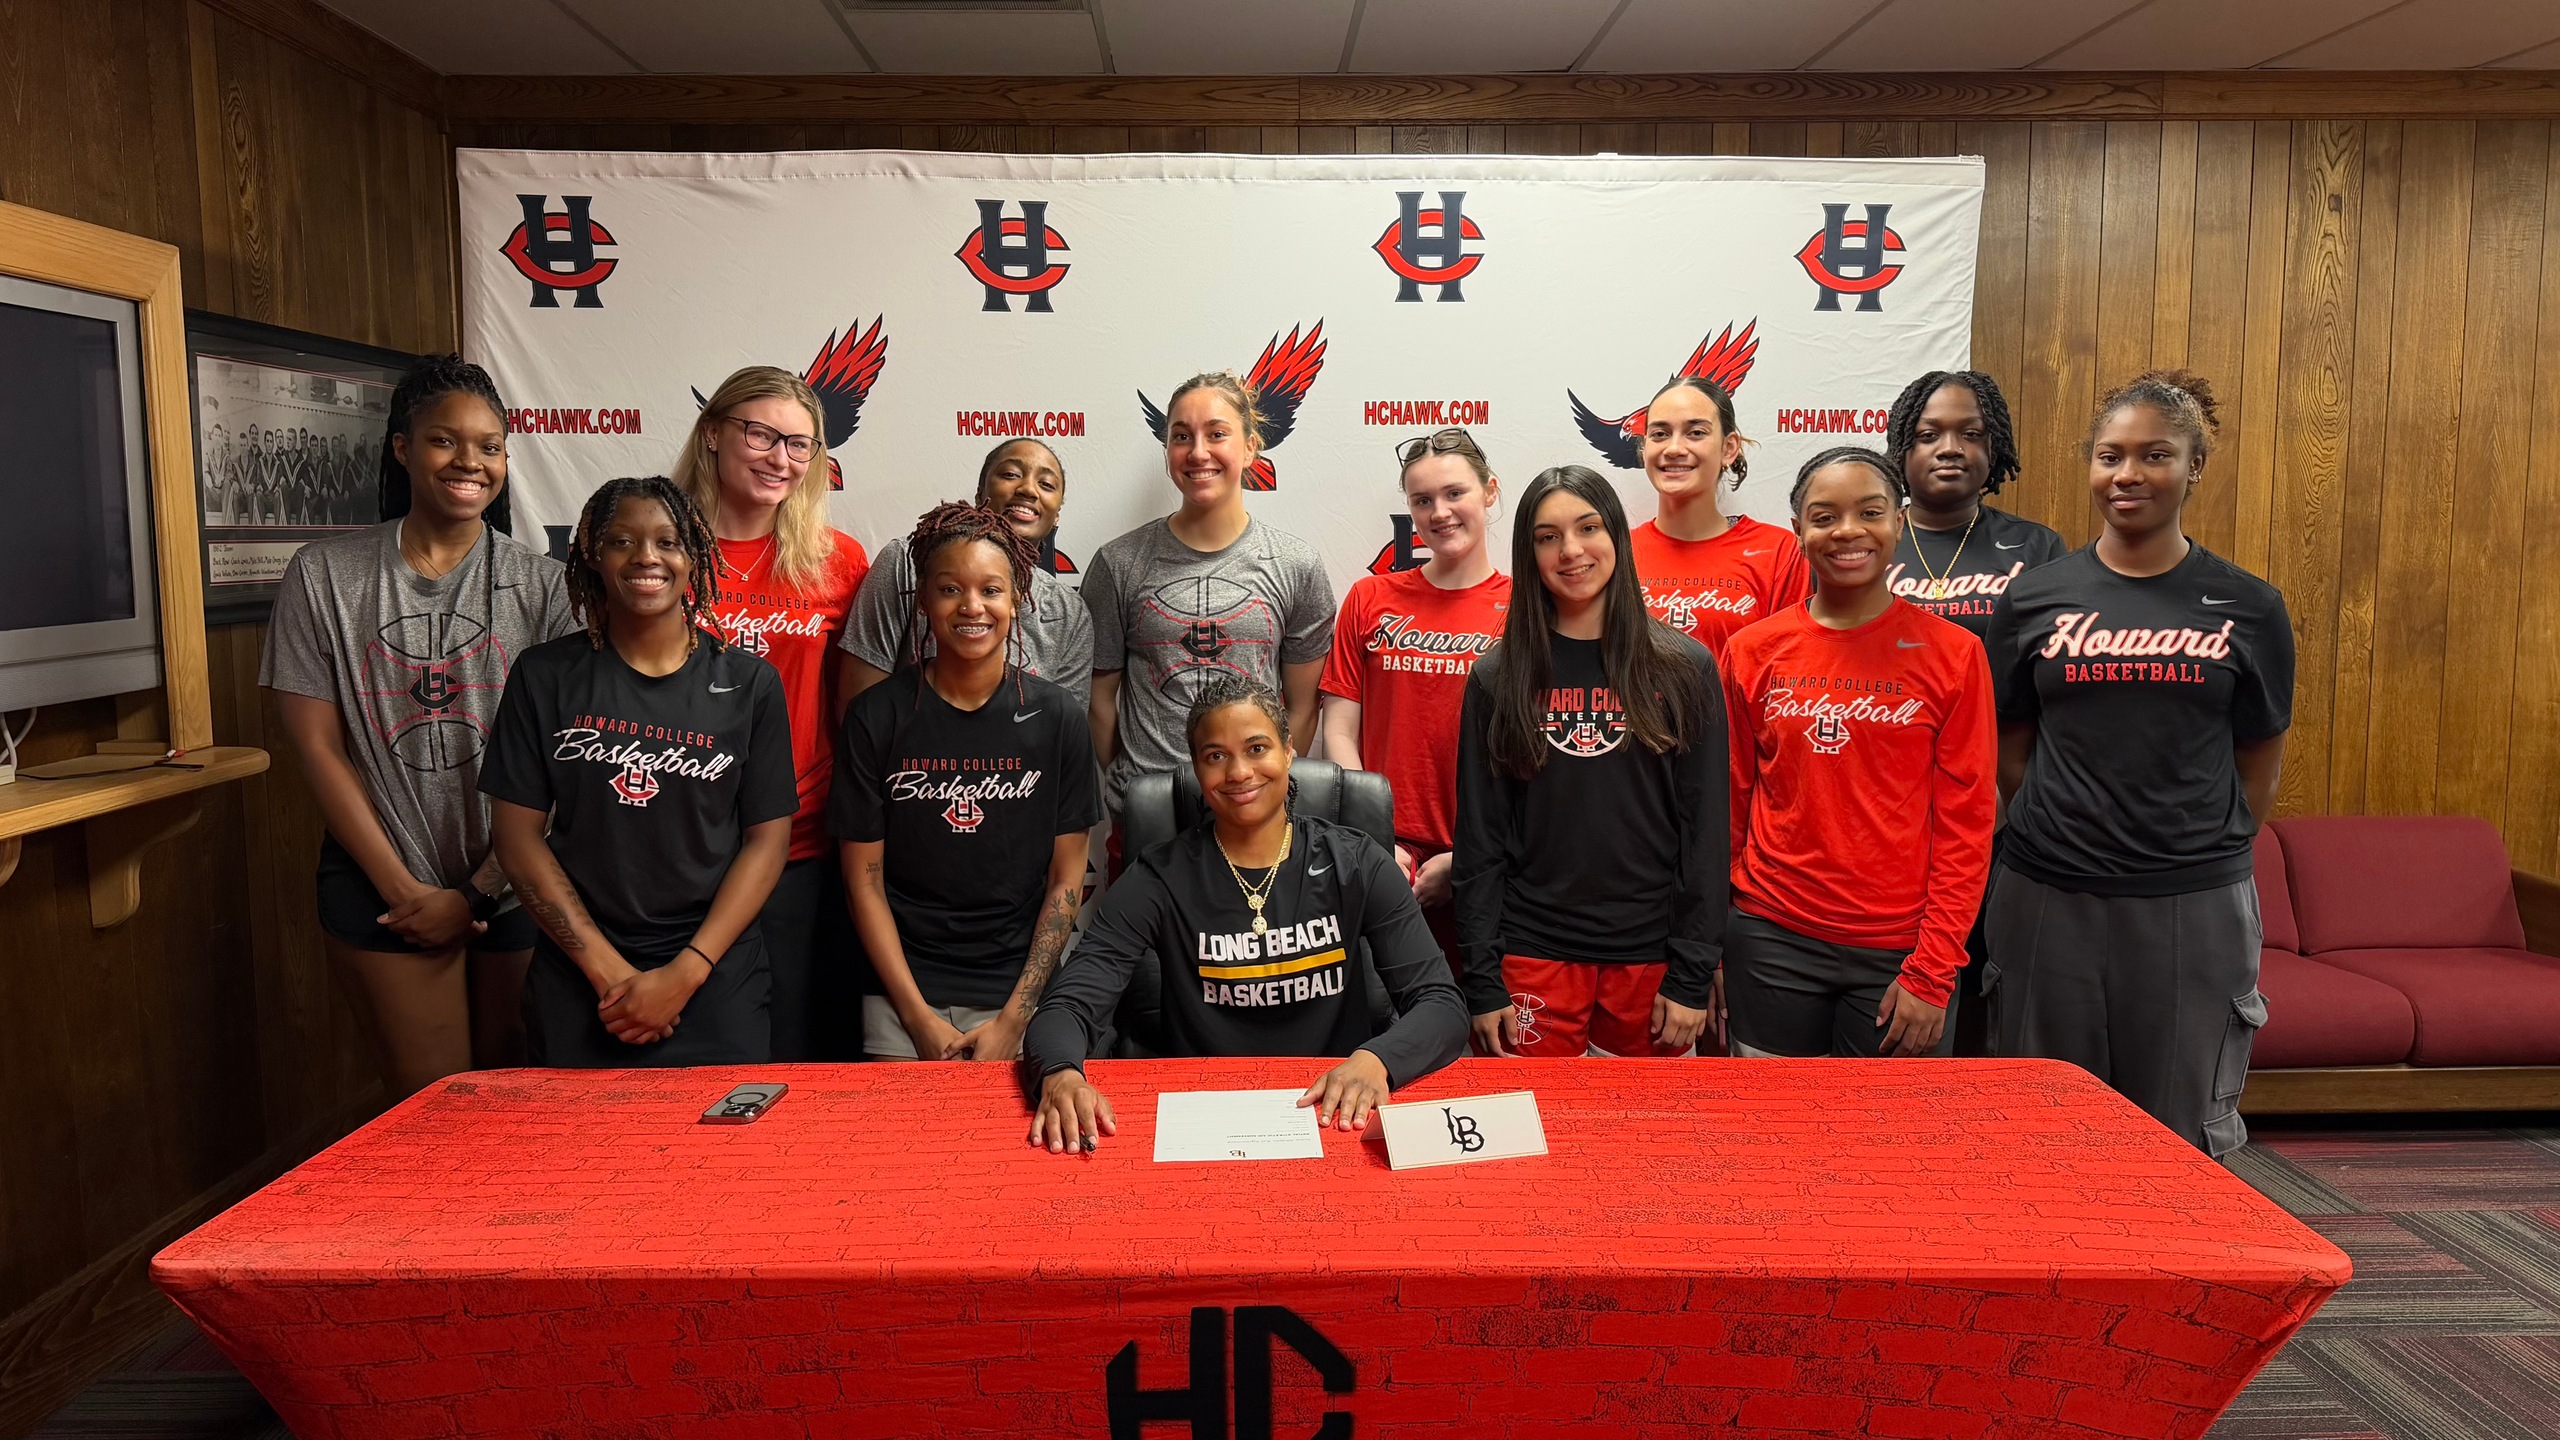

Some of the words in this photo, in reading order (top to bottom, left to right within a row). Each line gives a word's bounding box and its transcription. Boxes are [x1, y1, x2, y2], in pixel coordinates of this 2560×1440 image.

[507, 408, 642, 434] HCHAWK.COM
[956, 411, 1085, 437] HCHAWK.COM
[1364, 400, 1489, 425] HCHAWK.COM
[1777, 408, 1893, 434] HCHAWK.CO
[1640, 577, 1678, 587] WARD
[1684, 577, 1741, 591] COLLEGE
[750, 593, 810, 611] COLLEGE
[2041, 611, 2236, 661] Howard
[1770, 676, 1828, 690] HOWARD
[1834, 677, 1904, 696] COLLEGE
[2064, 662, 2206, 684] BASKETBALL
[1759, 687, 1924, 726] Basketball
[574, 714, 639, 736] HOWARD
[644, 724, 716, 750] COLLEGE
[553, 727, 735, 782] Basketball
[902, 757, 957, 771] HOWARD
[963, 757, 1022, 771] COLLEGE
[885, 769, 1042, 801] Basketball
[1198, 932, 1261, 962] LONG
[1265, 914, 1342, 957] BEACH
[1202, 966, 1345, 1007] BASKETBALL
[1440, 1106, 1485, 1155] LB
